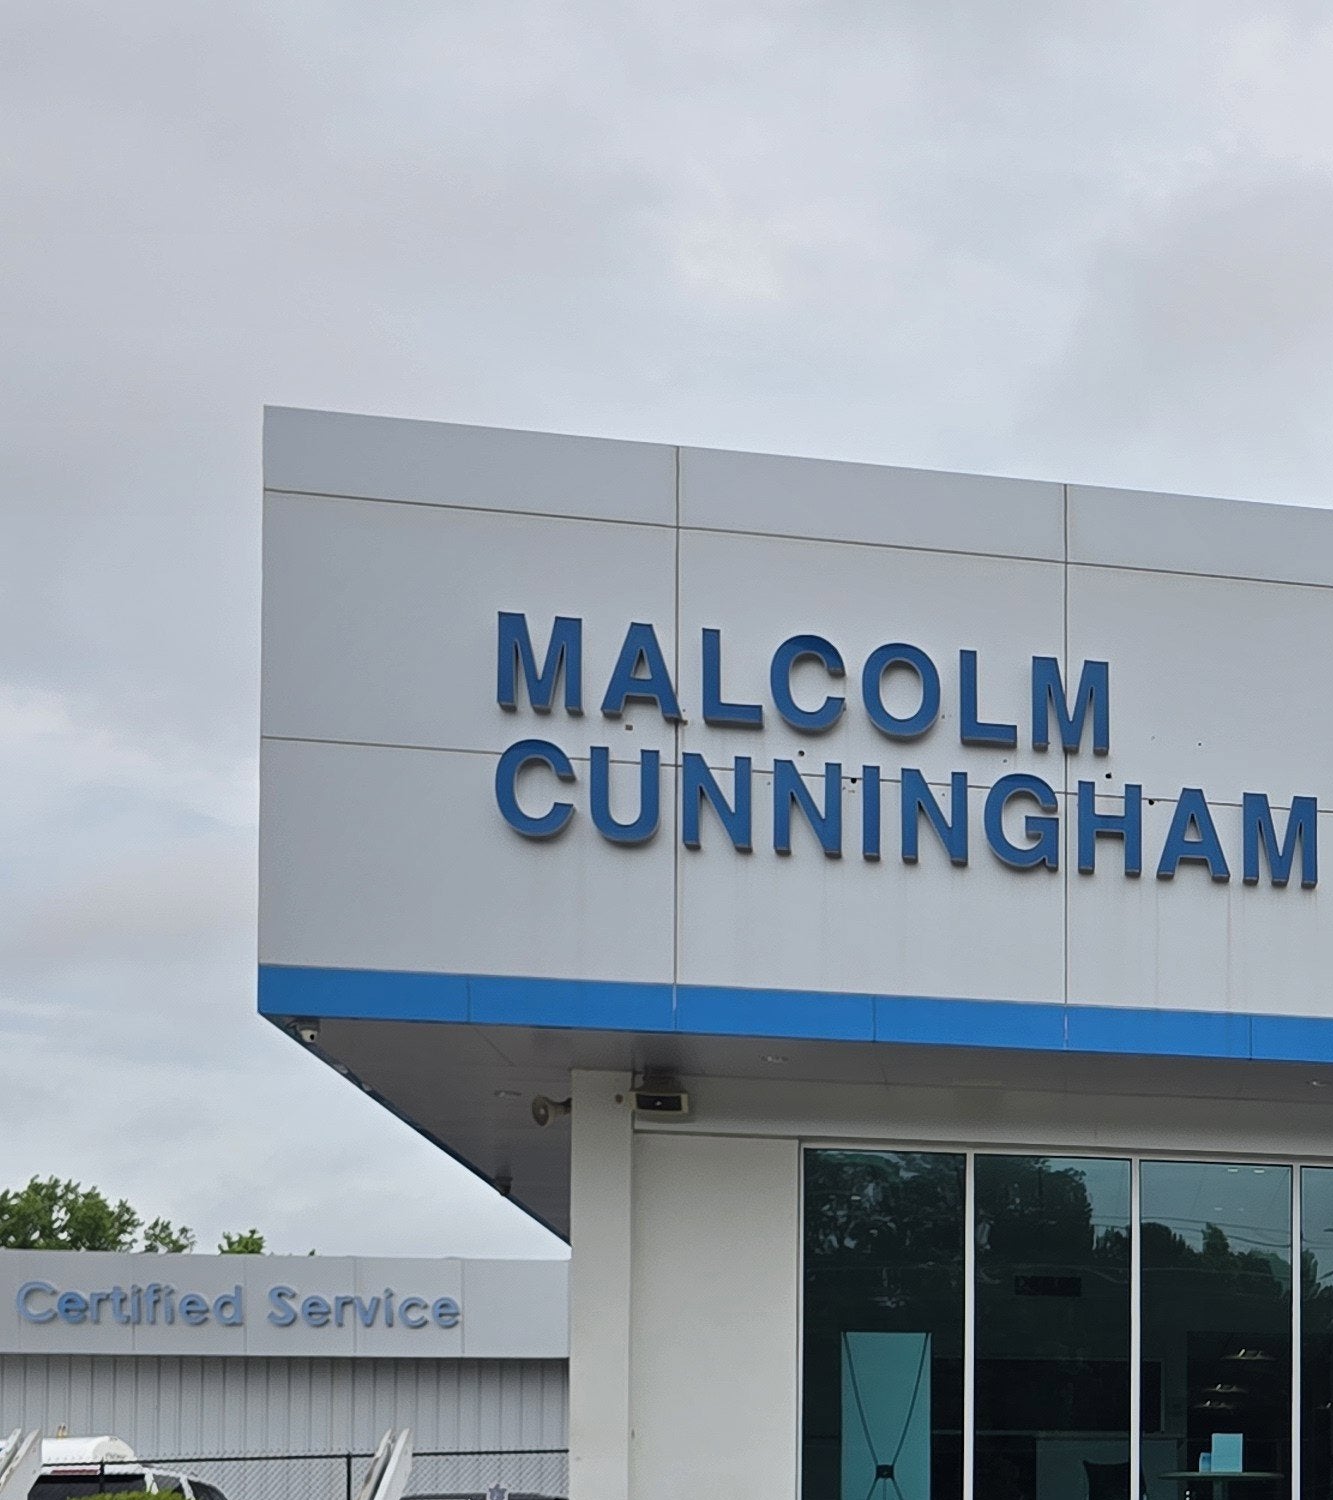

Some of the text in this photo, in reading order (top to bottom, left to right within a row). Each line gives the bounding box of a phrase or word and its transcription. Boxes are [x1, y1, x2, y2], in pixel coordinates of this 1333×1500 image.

[497, 610, 1110, 756] MALCOLM
[494, 738, 1319, 890] CUNNINGHAM
[15, 1281, 461, 1329] Certified Service
